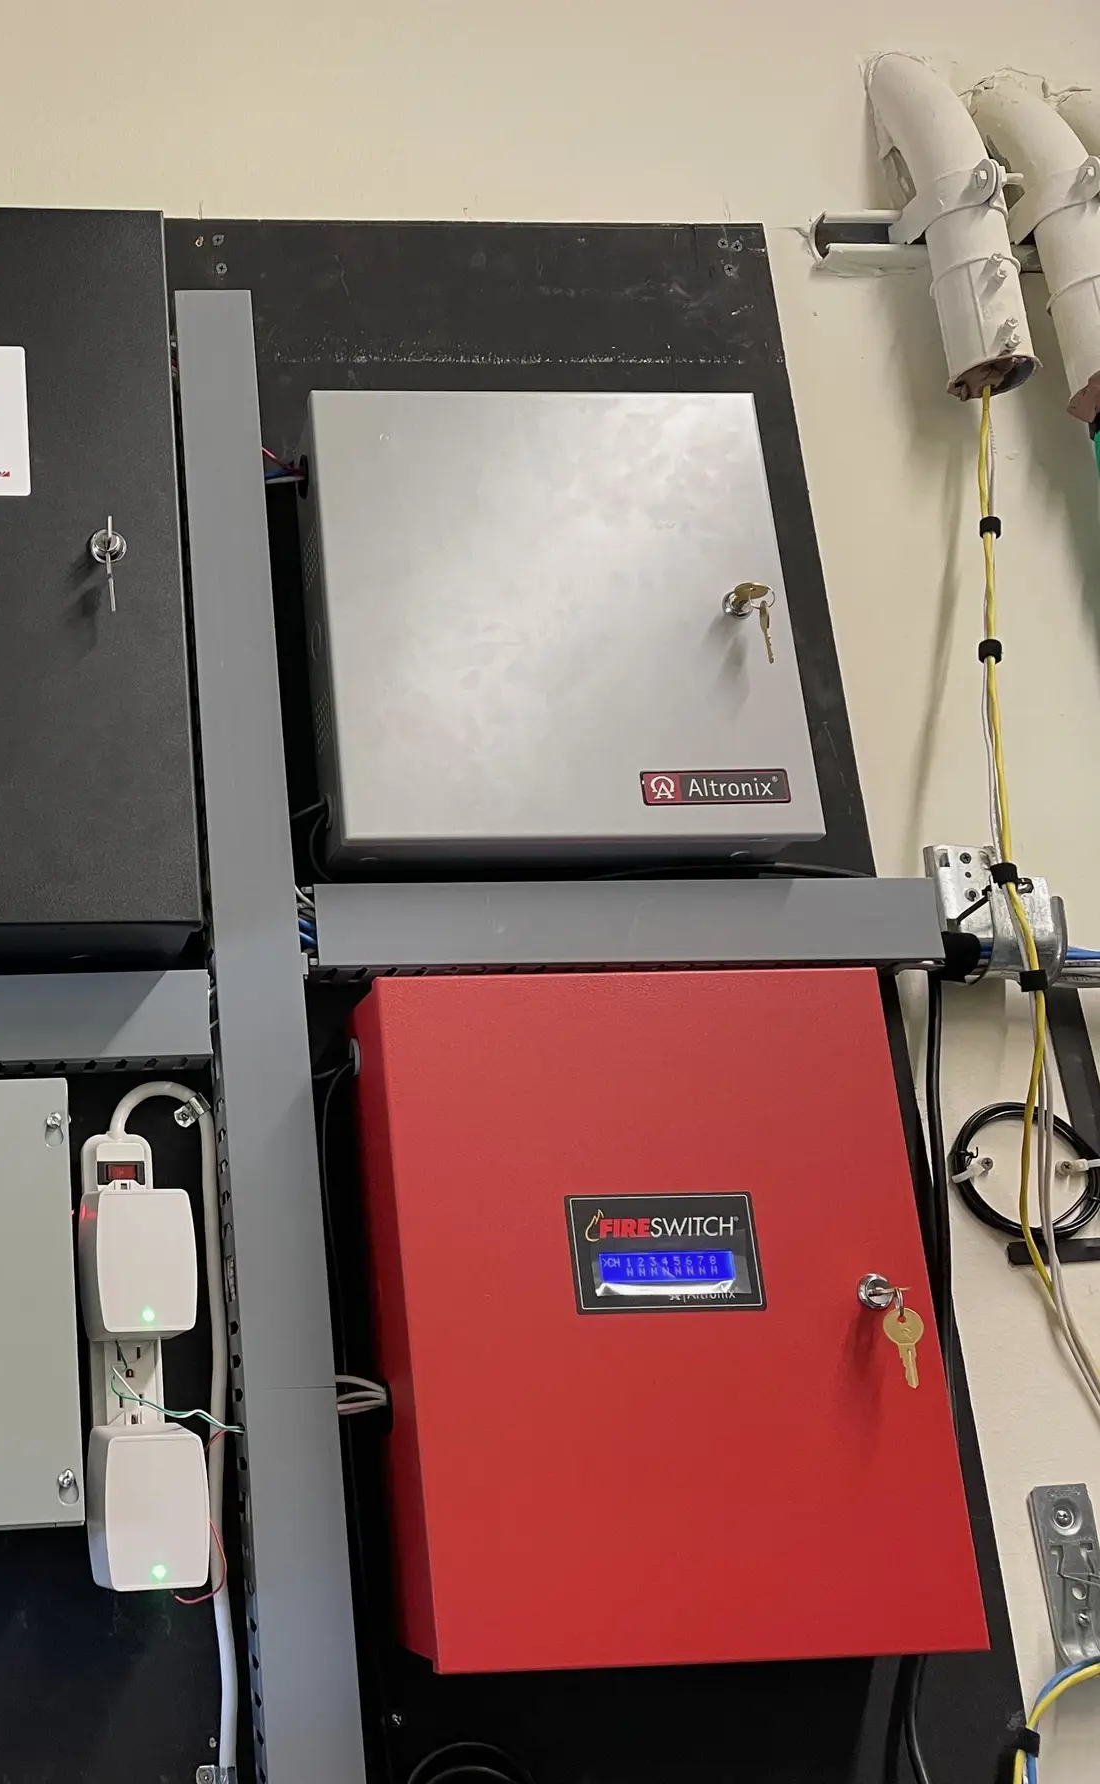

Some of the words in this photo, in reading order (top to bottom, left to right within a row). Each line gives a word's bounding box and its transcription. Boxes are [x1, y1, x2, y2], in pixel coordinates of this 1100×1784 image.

[627, 1258, 631, 1267] 1
[638, 1257, 644, 1267] 2
[650, 1257, 656, 1266] 3
[662, 1257, 669, 1265] 4
[673, 1256, 680, 1265] 5
[686, 1256, 692, 1265] 6
[697, 1256, 703, 1264] 7
[710, 1256, 716, 1264] 8
